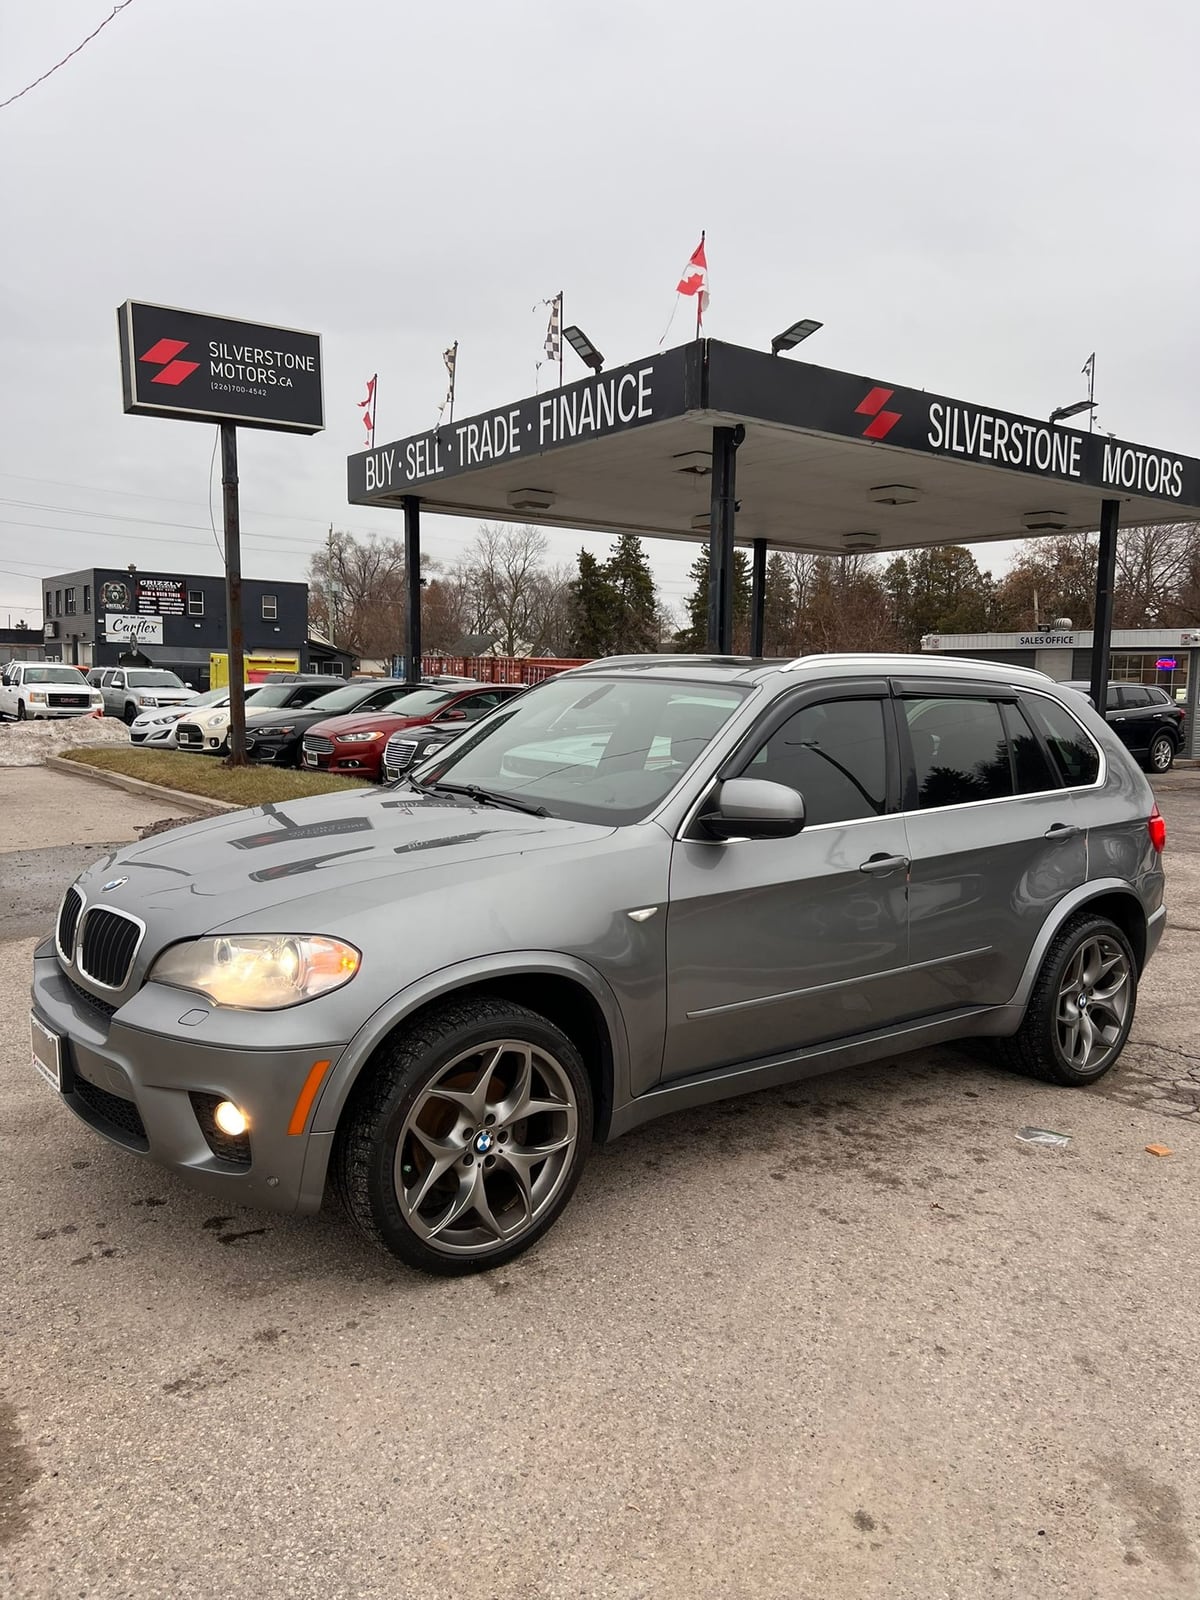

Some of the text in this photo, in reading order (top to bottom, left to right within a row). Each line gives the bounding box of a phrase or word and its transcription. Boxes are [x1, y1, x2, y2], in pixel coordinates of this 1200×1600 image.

[209, 341, 315, 372] SILVERSTONE
[210, 382, 267, 397] (226)700-4542
[366, 366, 655, 491] BUY SELL TRADE FINANCE
[928, 402, 1183, 498] SILVERSTONE MOTORS
[140, 580, 182, 588] GRIZZLY
[113, 619, 157, 635] Carflex
[1020, 635, 1074, 645] SALES OFFICE
